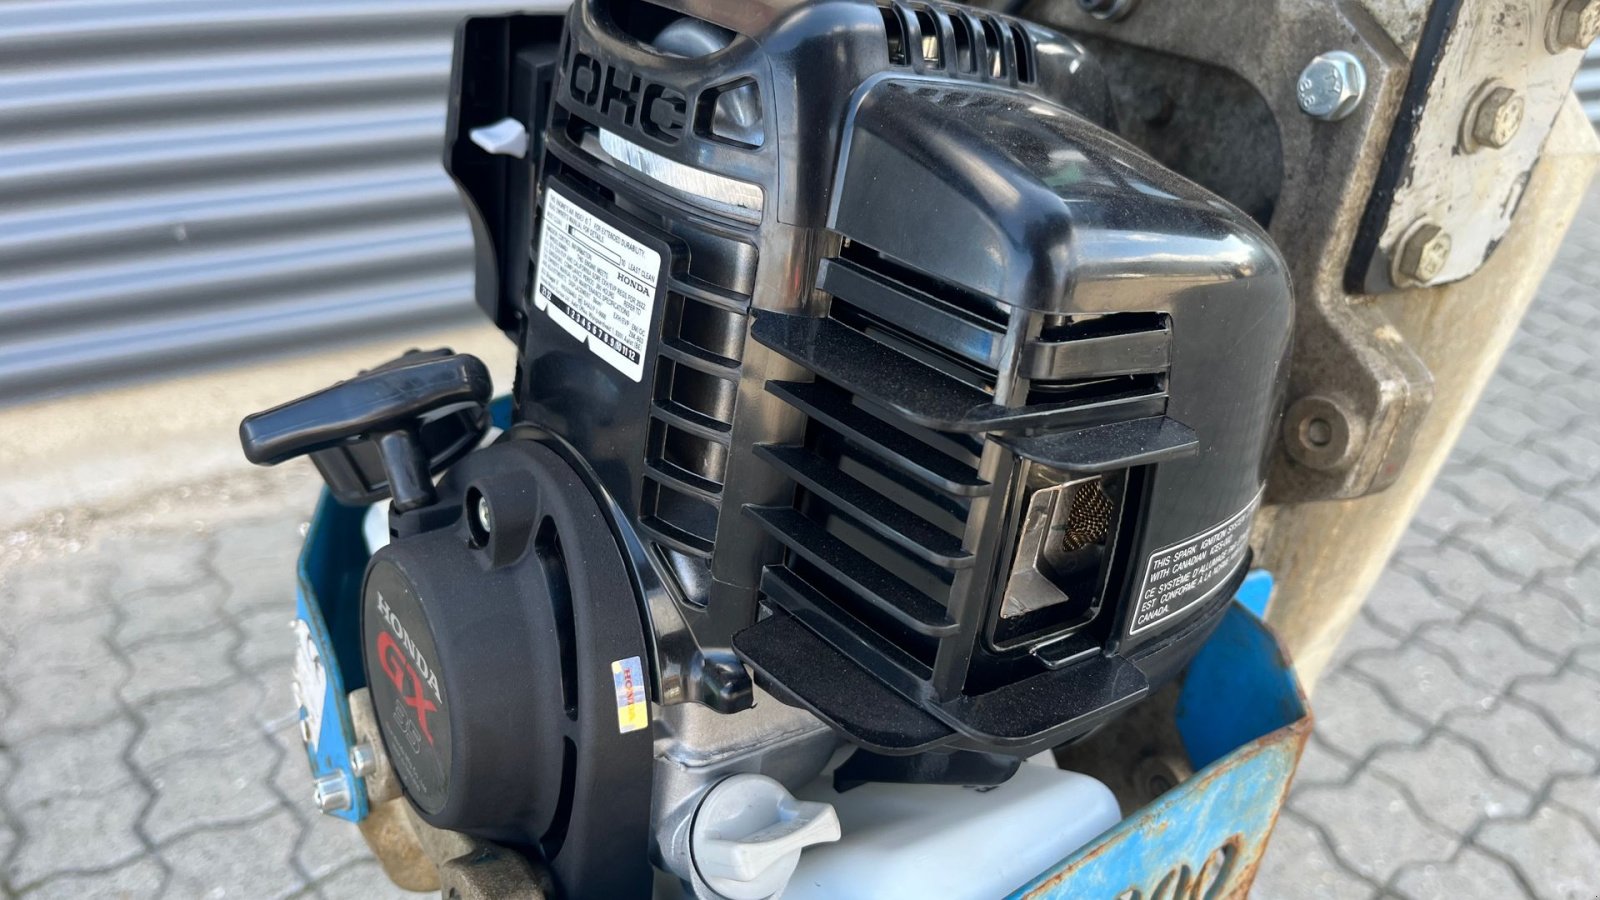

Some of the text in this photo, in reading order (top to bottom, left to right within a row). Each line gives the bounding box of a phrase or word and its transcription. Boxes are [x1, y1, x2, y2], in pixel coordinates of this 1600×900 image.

[569, 53, 686, 147] OHC
[617, 272, 650, 297] HONDA
[628, 262, 640, 275] LEAST
[641, 268, 655, 283] CLEAN
[571, 310, 575, 318] 2
[576, 314, 581, 323] 3
[581, 318, 586, 327] 4
[586, 322, 591, 331] 5
[592, 326, 597, 335] 6
[598, 330, 603, 338] 7
[604, 334, 608, 342] 8
[610, 338, 615, 347] 9
[622, 346, 627, 356] 11
[628, 349, 636, 361] 12
[1150, 568, 1170, 583] WITH
[1172, 551, 1207, 574] CANADIAN
[1154, 556, 1171, 570] THIS
[1173, 544, 1197, 562] SPARK
[1200, 528, 1227, 550] IGNITION
[1141, 599, 1157, 612] EST
[1160, 578, 1197, 604] CONFORME
[1204, 570, 1212, 582] LA
[1144, 587, 1156, 599] CE
[1158, 571, 1191, 594] SYSTÈME
[376, 591, 442, 705] HONDA
[376, 630, 438, 748] GX
